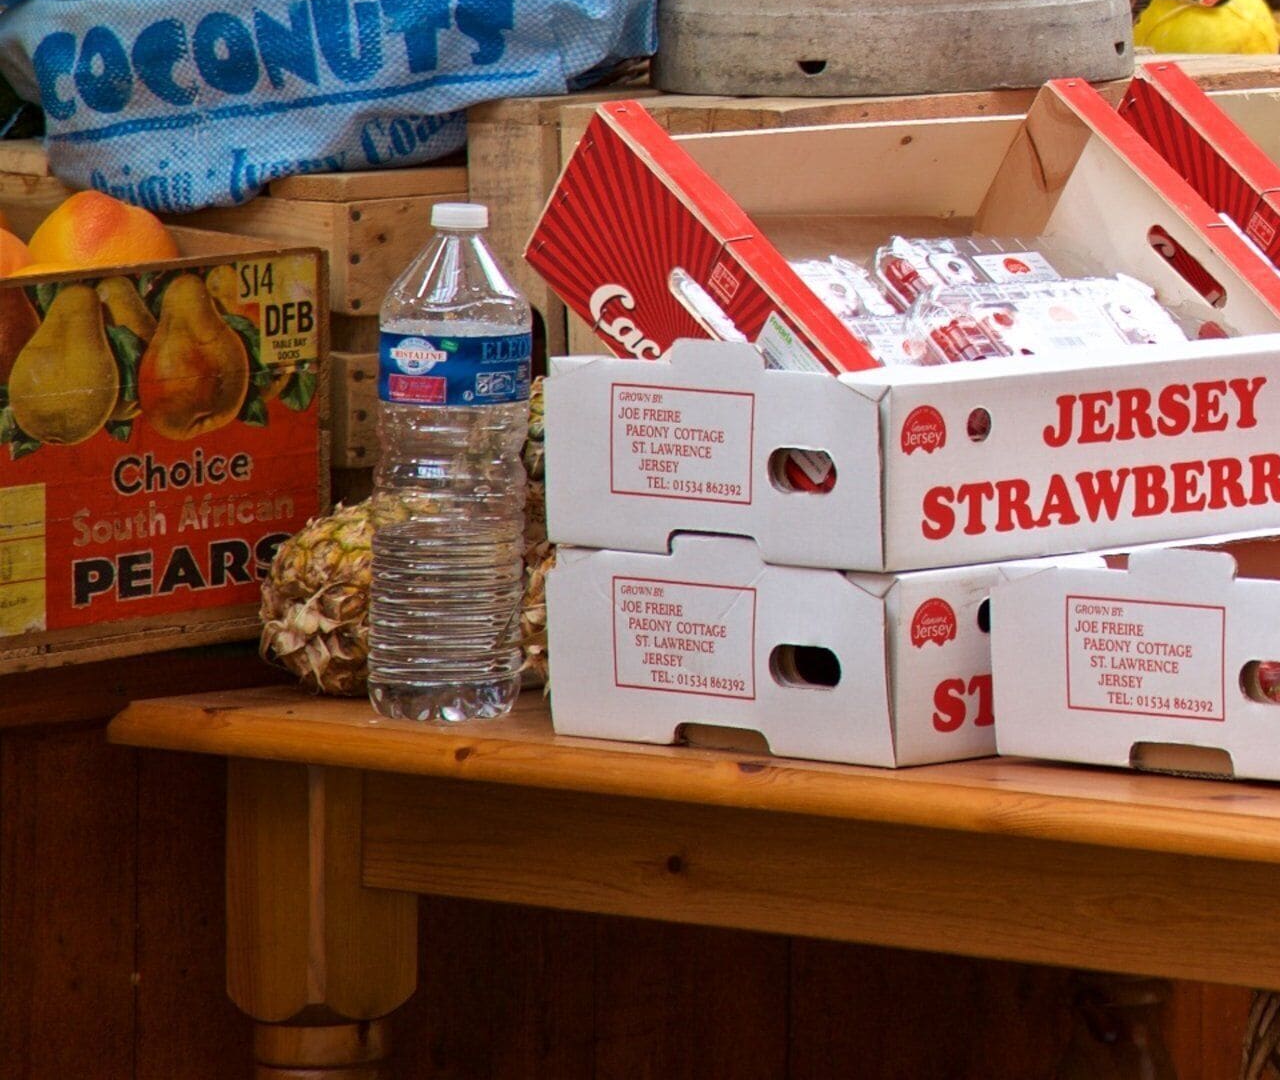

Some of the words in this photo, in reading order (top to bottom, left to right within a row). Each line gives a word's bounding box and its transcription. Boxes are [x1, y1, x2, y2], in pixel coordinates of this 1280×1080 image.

[265, 301, 314, 337] DFB
[619, 392, 651, 402] GROWN
[618, 407, 640, 420] JOE
[642, 409, 681, 423] FREIRE
[1043, 376, 1267, 448] JERSEY
[626, 424, 670, 439] PAEONY
[674, 427, 725, 443] COTTAGE
[903, 431, 943, 446] Jersey
[650, 442, 712, 459] LAWRENCE
[112, 447, 252, 496] Choice
[638, 459, 680, 473] JERSEY
[647, 476, 670, 490] TEL:
[673, 480, 703, 494] 01534
[706, 482, 742, 496] 862392
[72, 499, 167, 547] South
[177, 493, 295, 533] African
[620, 584, 652, 595] GROWN
[621, 600, 643, 613] JOE
[645, 602, 683, 617] FREIRE
[1075, 604, 1110, 616] GROWN
[628, 617, 672, 633] PAEONY
[676, 621, 727, 638] COTTAGE
[914, 622, 953, 639] Jersey
[1075, 620, 1098, 633] JOE
[1101, 621, 1144, 636] FREIRE
[654, 636, 715, 653] LAWRENCE
[1083, 637, 1131, 653] PAEONY
[1136, 641, 1193, 658] COTTAGE
[642, 652, 683, 667] JERSEY
[1111, 656, 1179, 674] LAWRENCE
[651, 670, 674, 684] TEL:
[677, 673, 707, 688] 01534
[710, 677, 745, 691] 862392
[1098, 673, 1143, 689] JERSEY
[1107, 691, 1133, 706] TEL:
[1136, 695, 1170, 710] 01534
[1173, 698, 1213, 713] 862392
